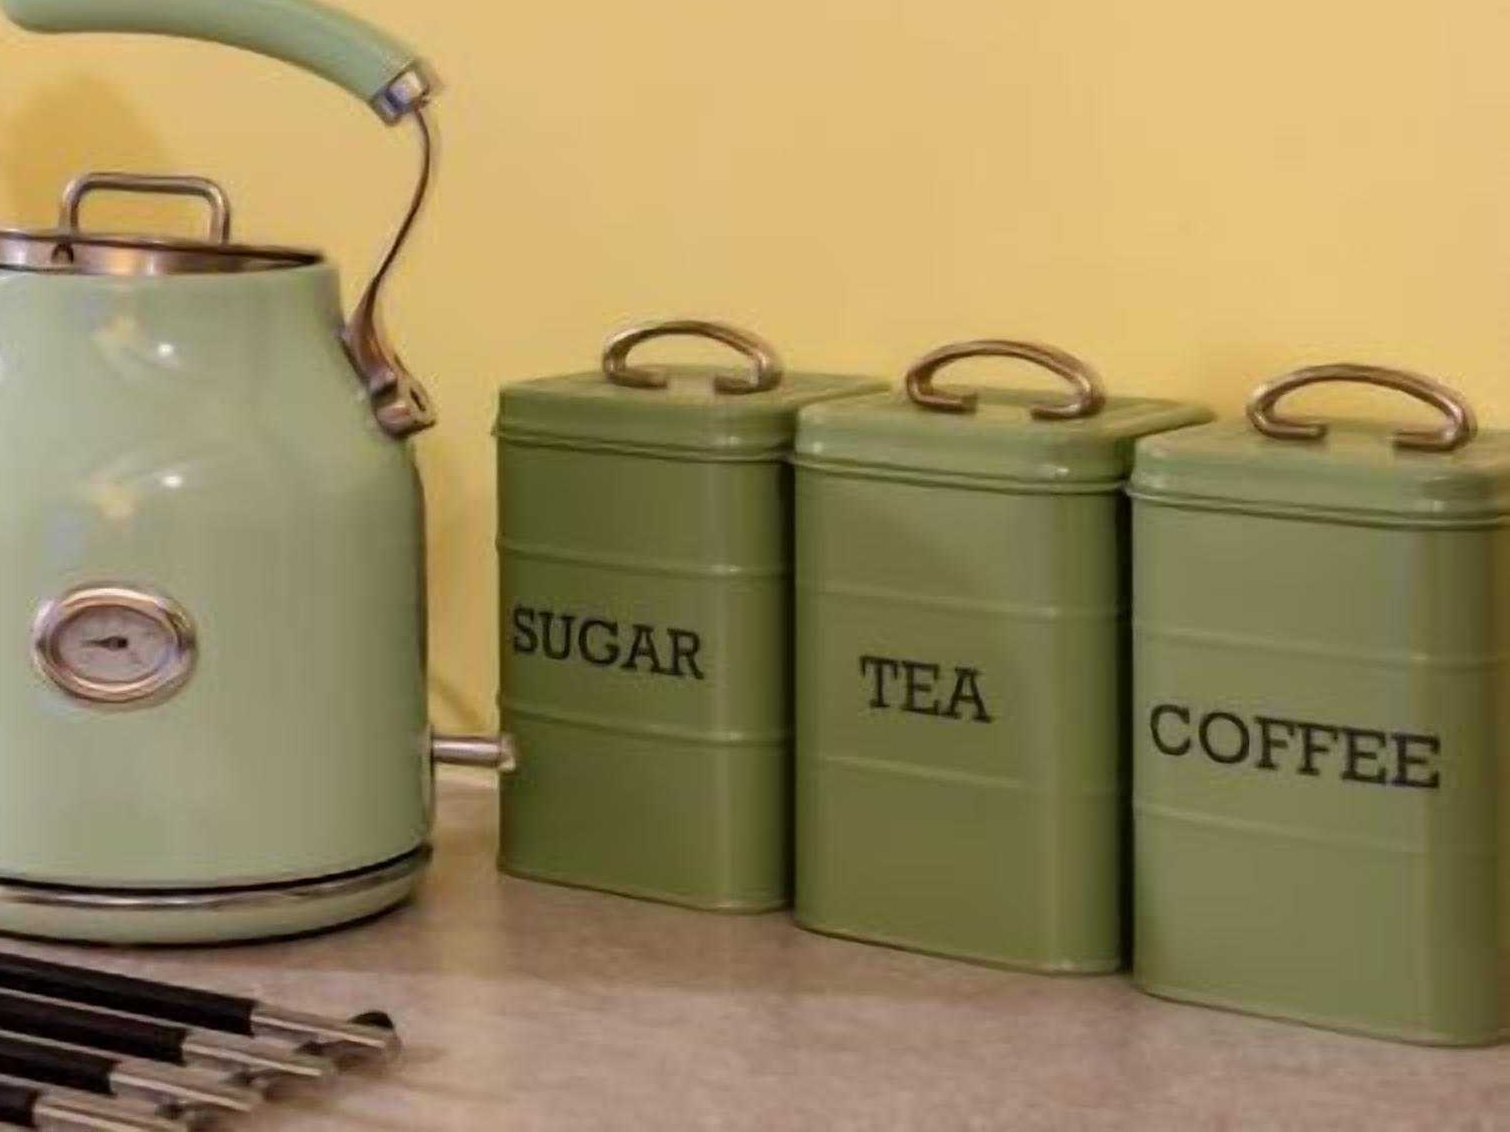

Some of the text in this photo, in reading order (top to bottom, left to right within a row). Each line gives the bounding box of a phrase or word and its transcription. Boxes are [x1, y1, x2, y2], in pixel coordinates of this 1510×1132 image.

[512, 606, 705, 680] SUGAR
[859, 655, 994, 723] TEA
[1150, 704, 1440, 788] COFFEE
